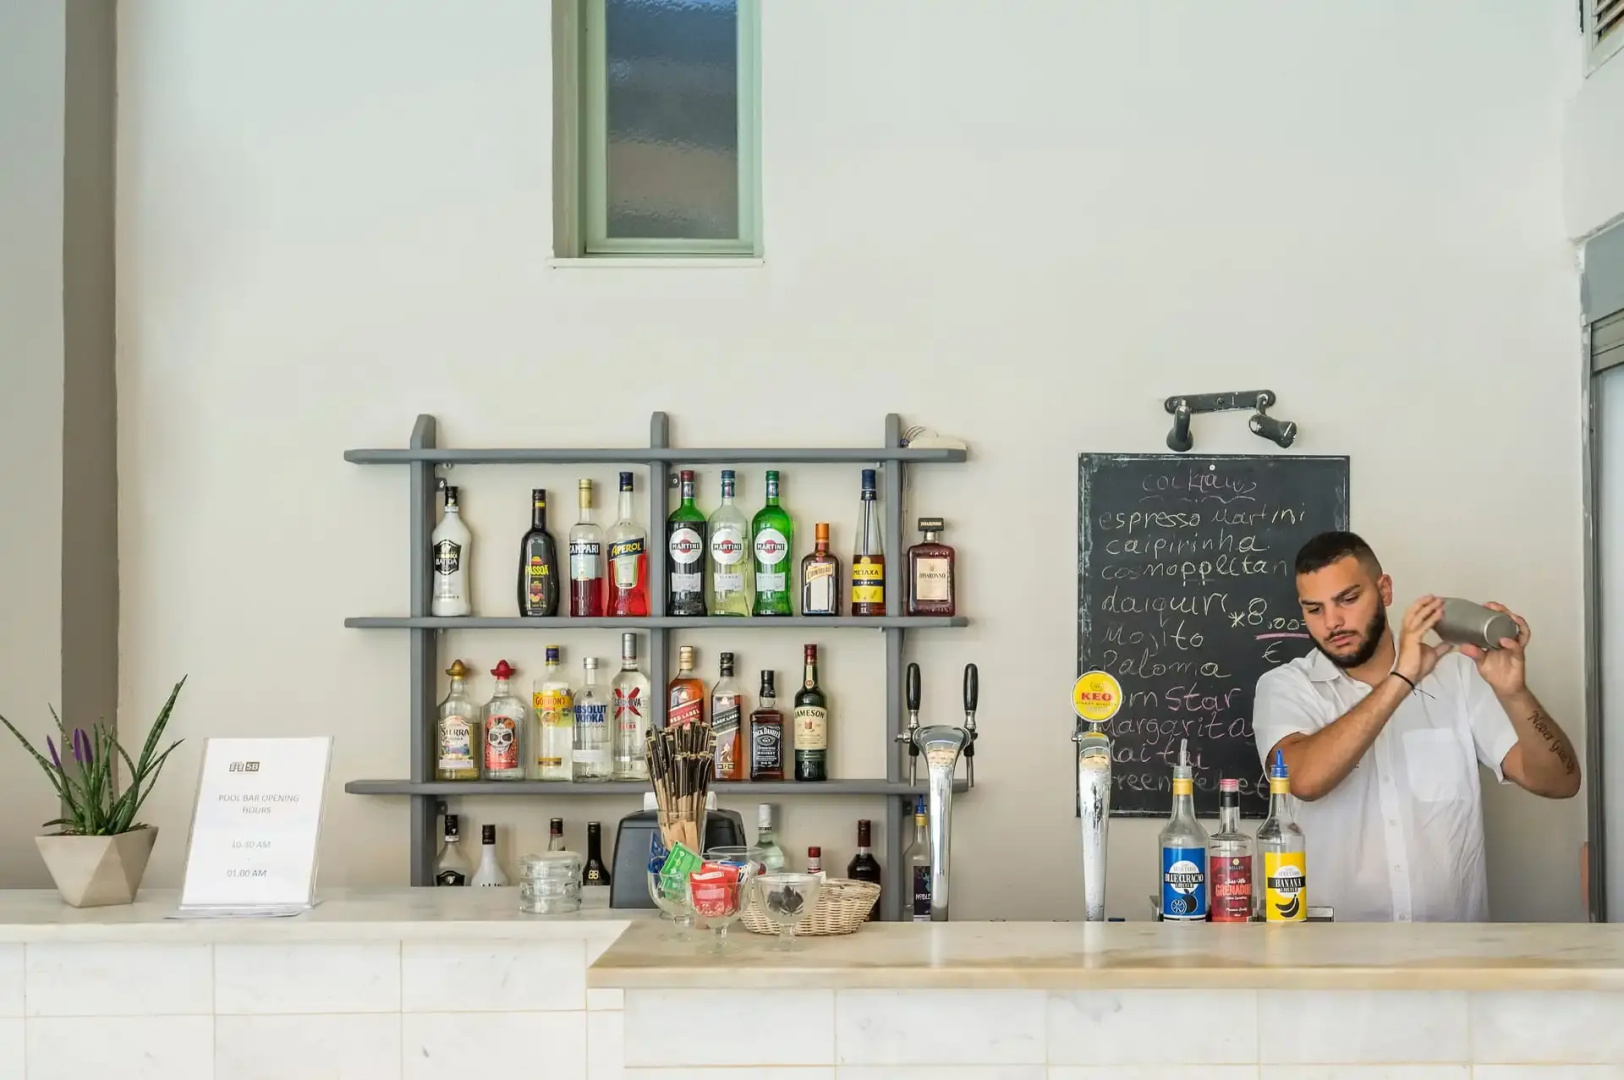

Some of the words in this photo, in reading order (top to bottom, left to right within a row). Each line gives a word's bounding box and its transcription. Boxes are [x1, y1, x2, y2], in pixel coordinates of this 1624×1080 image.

[1099, 512, 1201, 534] espresso
[612, 542, 642, 556] APEROL
[672, 542, 700, 550] MARTINI
[713, 543, 742, 551] MARTINI
[756, 543, 785, 551] MARTINI
[1103, 647, 1232, 679] Paloma
[1081, 692, 1112, 702] KEO
[1165, 682, 1242, 712] Star
[574, 705, 608, 714] ABSOLUT
[682, 709, 700, 719] LABEL
[795, 709, 826, 719] JAMESON
[576, 713, 605, 723] VODKA
[441, 728, 470, 737] SIERRA
[1111, 773, 1171, 792] reen
[243, 794, 260, 802] BAR
[261, 794, 300, 803] OPENING
[256, 840, 271, 848] AM
[252, 869, 267, 877] AM
